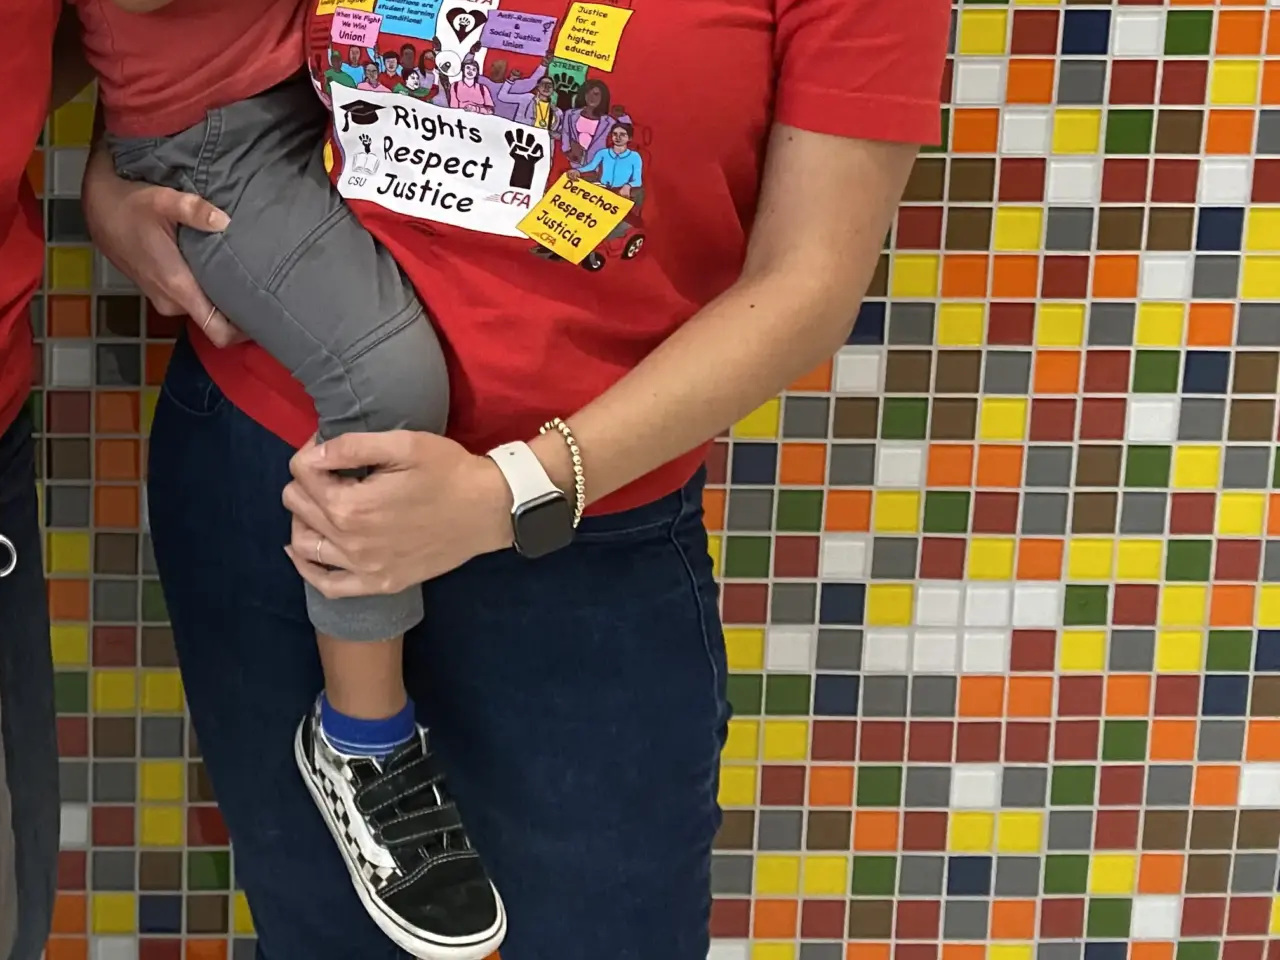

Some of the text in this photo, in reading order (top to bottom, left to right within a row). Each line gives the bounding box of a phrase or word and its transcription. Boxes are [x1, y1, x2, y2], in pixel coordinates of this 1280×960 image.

[352, 12, 362, 20] We
[363, 15, 381, 24] Fight
[378, 4, 435, 19] student learning
[497, 12, 542, 24] Anti-Racism
[577, 6, 608, 19] Justice
[342, 20, 367, 30] We Win!
[385, 14, 422, 24] conditions!
[575, 16, 589, 24] for
[339, 30, 366, 43] Union!
[489, 28, 541, 42] Social Justice
[571, 25, 599, 37] better
[502, 40, 524, 49] Union
[567, 34, 596, 46] higher
[565, 45, 610, 62] education!
[552, 61, 584, 73] STRIKE!
[392, 105, 483, 142] Rights
[383, 135, 493, 181] Respect
[348, 176, 367, 187] CSU
[376, 172, 474, 213] Justice
[563, 180, 620, 215] Derechos
[500, 190, 532, 209] CFA
[549, 194, 597, 229] Respeto
[536, 210, 582, 248] Justicia
[540, 232, 557, 246] CFA
